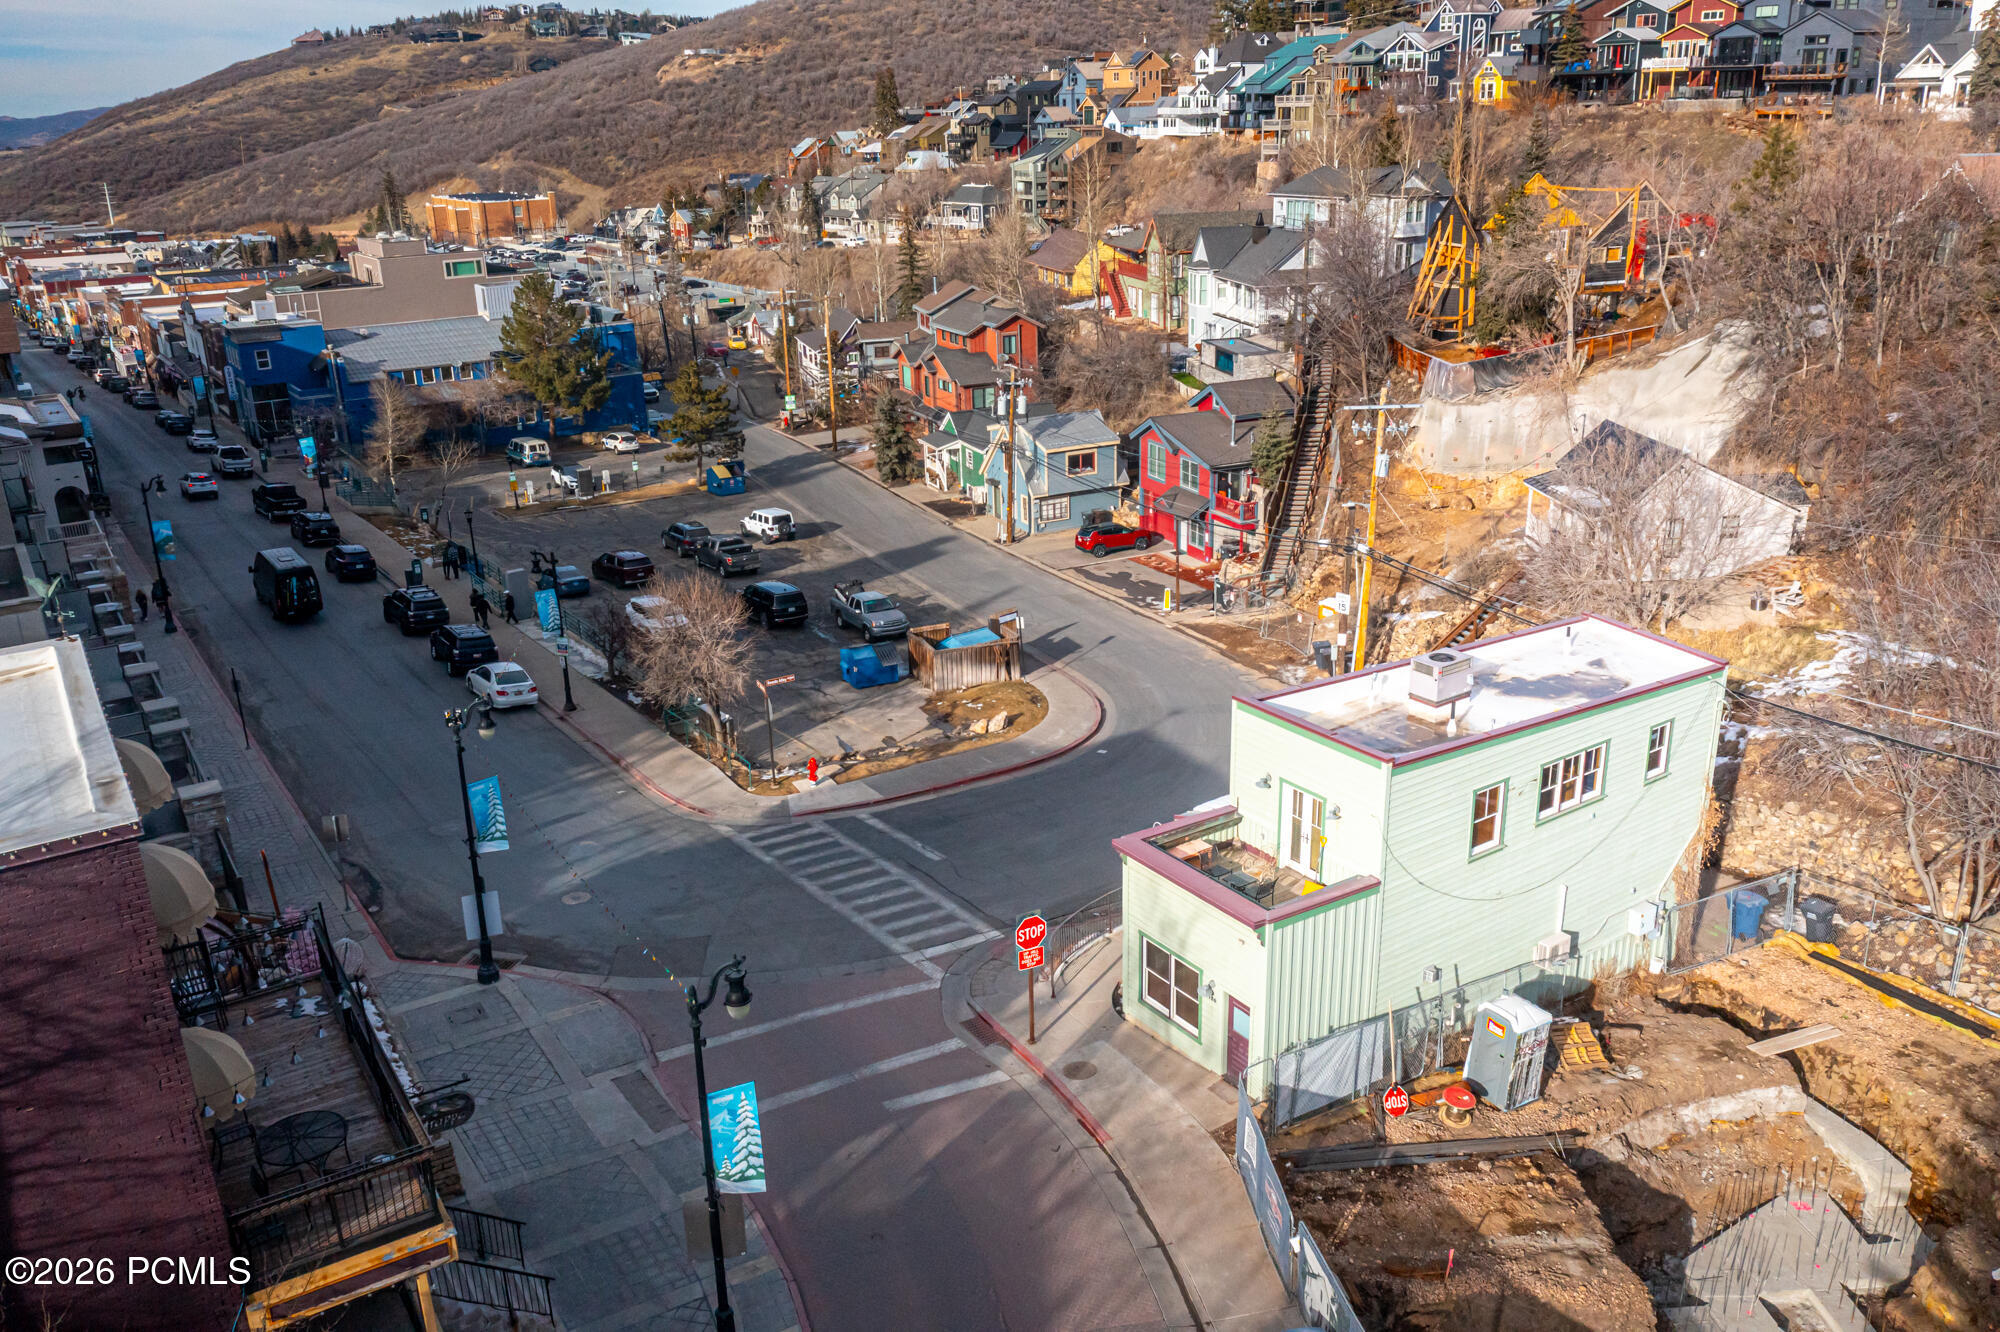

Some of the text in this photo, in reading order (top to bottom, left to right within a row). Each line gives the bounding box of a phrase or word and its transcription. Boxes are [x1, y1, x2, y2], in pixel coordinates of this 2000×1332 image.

[1338, 602, 1347, 612] 15
[1018, 924, 1044, 942] STOP
[1386, 1095, 1407, 1109] STOP
